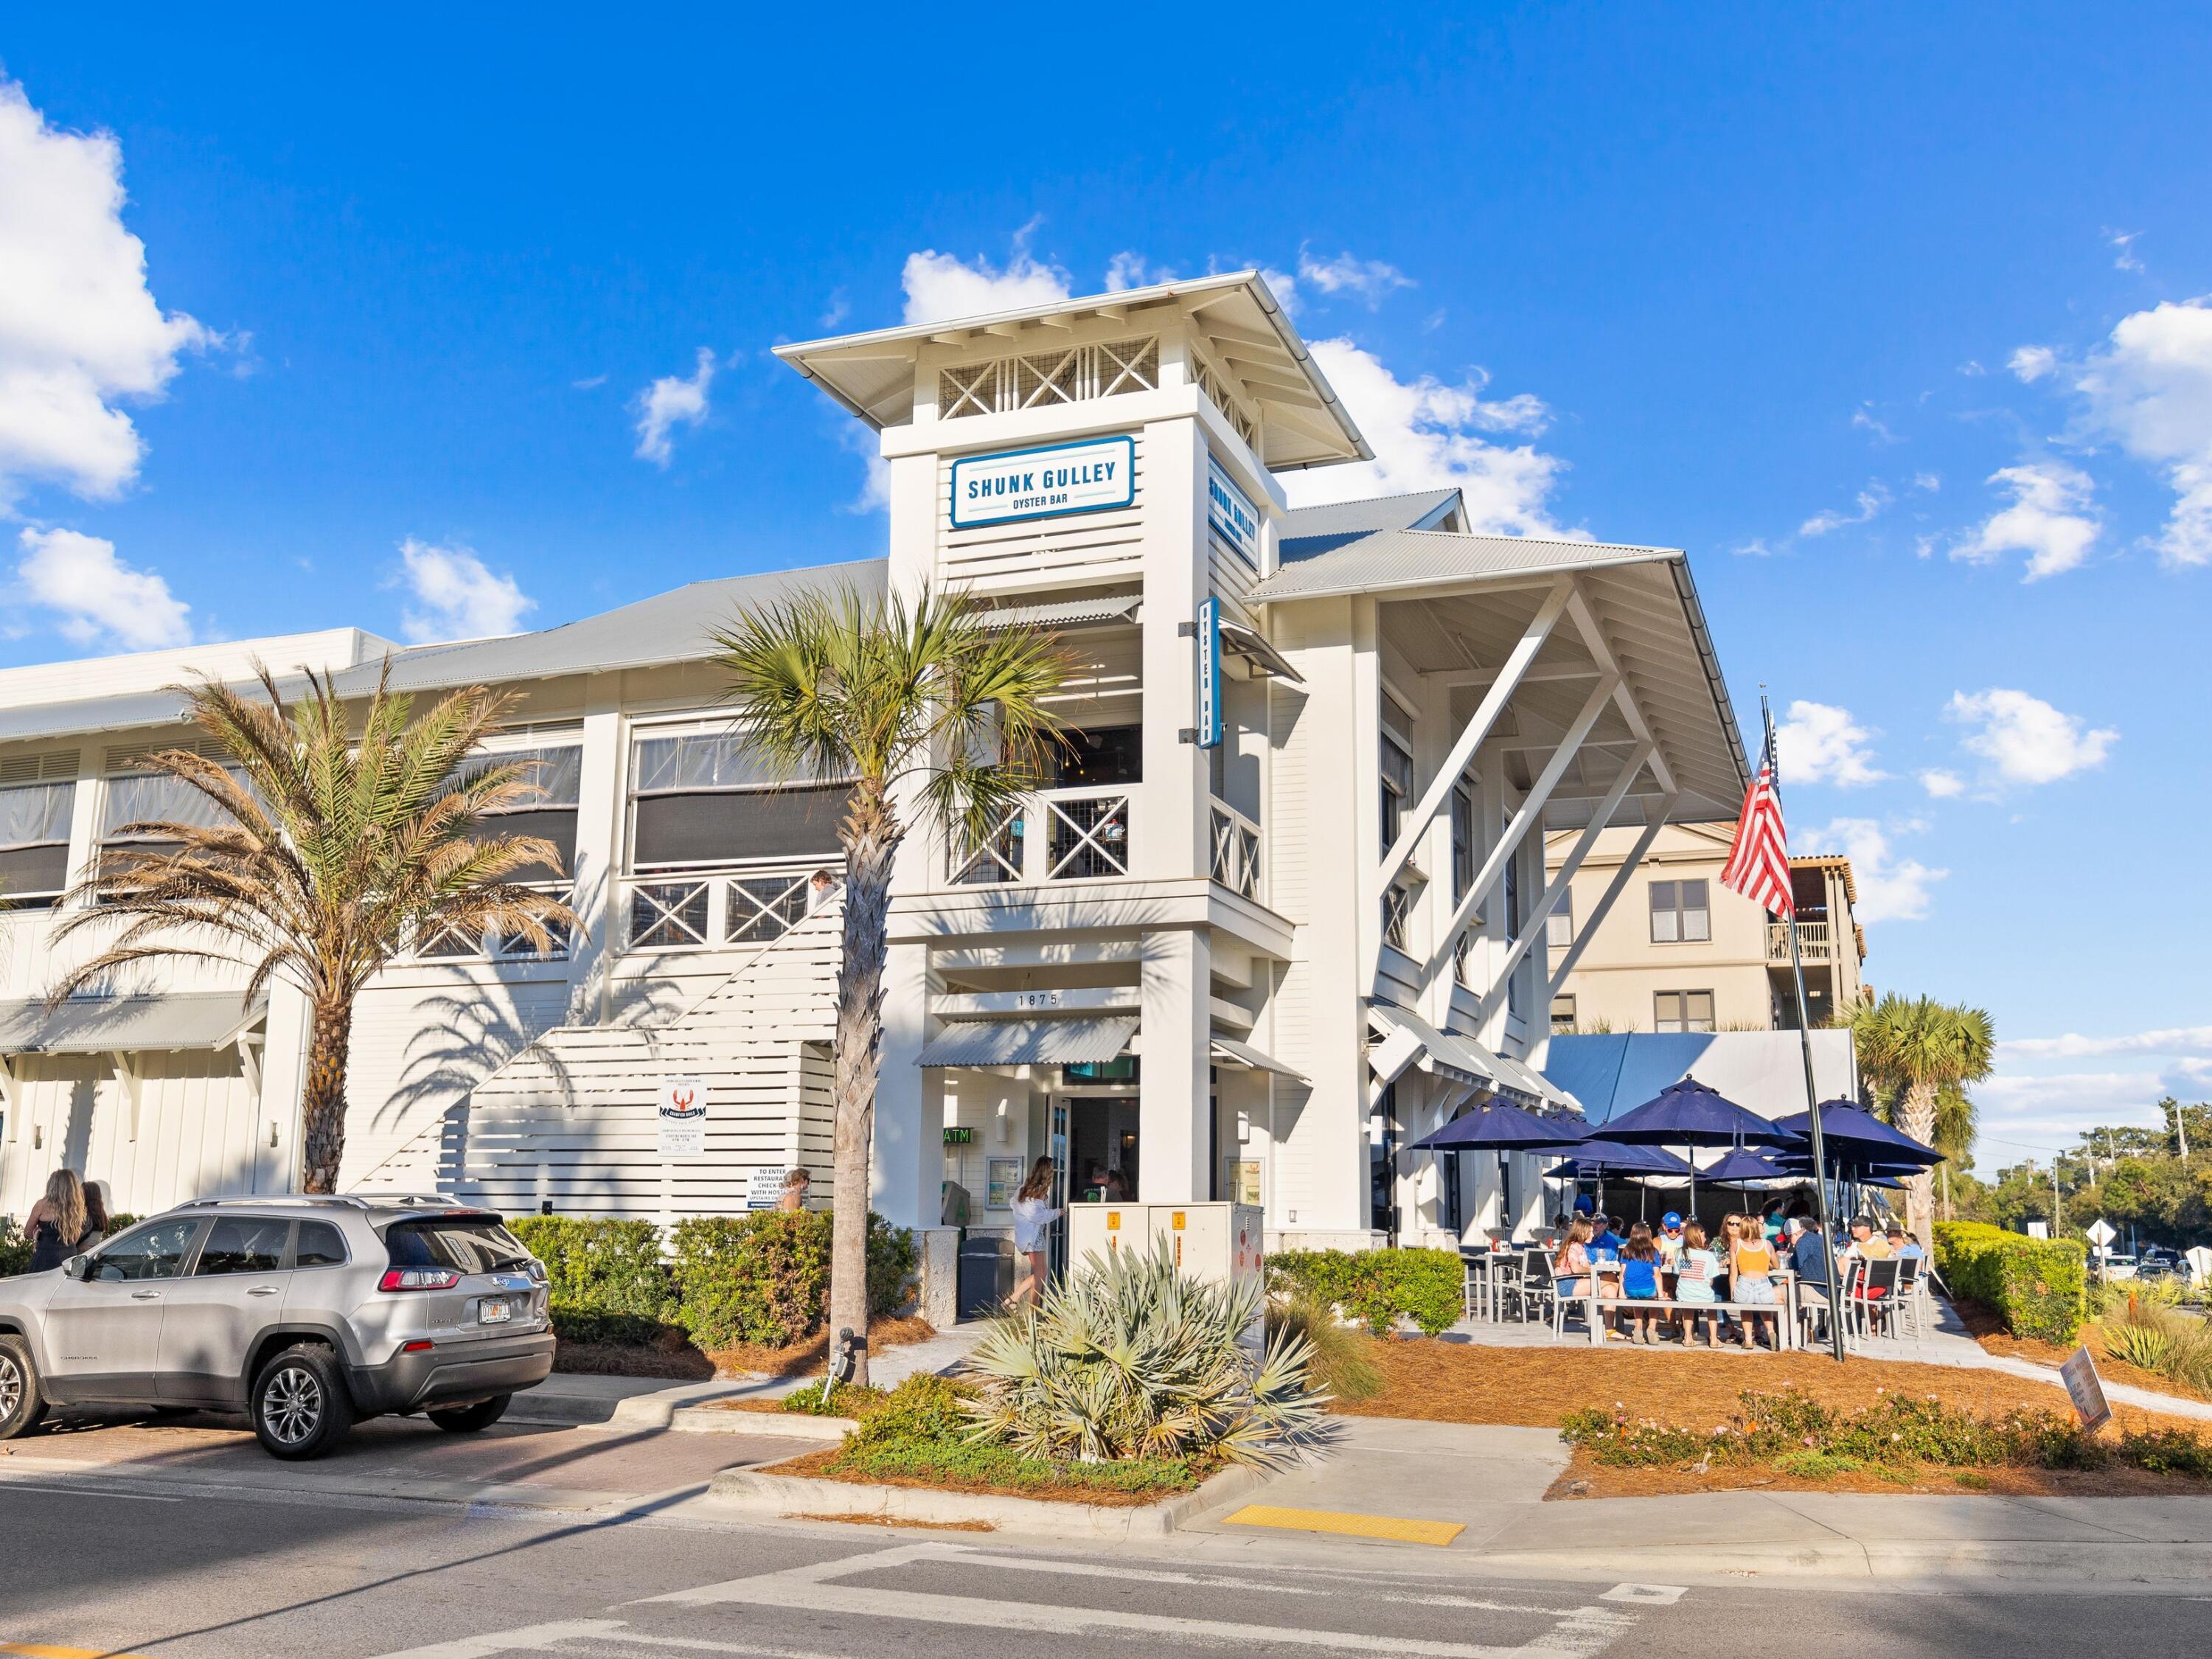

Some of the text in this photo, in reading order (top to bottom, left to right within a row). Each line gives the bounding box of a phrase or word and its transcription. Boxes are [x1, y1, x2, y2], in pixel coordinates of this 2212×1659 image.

[968, 462, 1115, 499] SHUNK GULLEY
[1013, 493, 1068, 509] OYSTER BAR
[1019, 994, 1057, 1006] 1875
[943, 1129, 969, 1142] ATM
[492, 1276, 510, 1287] Jeep
